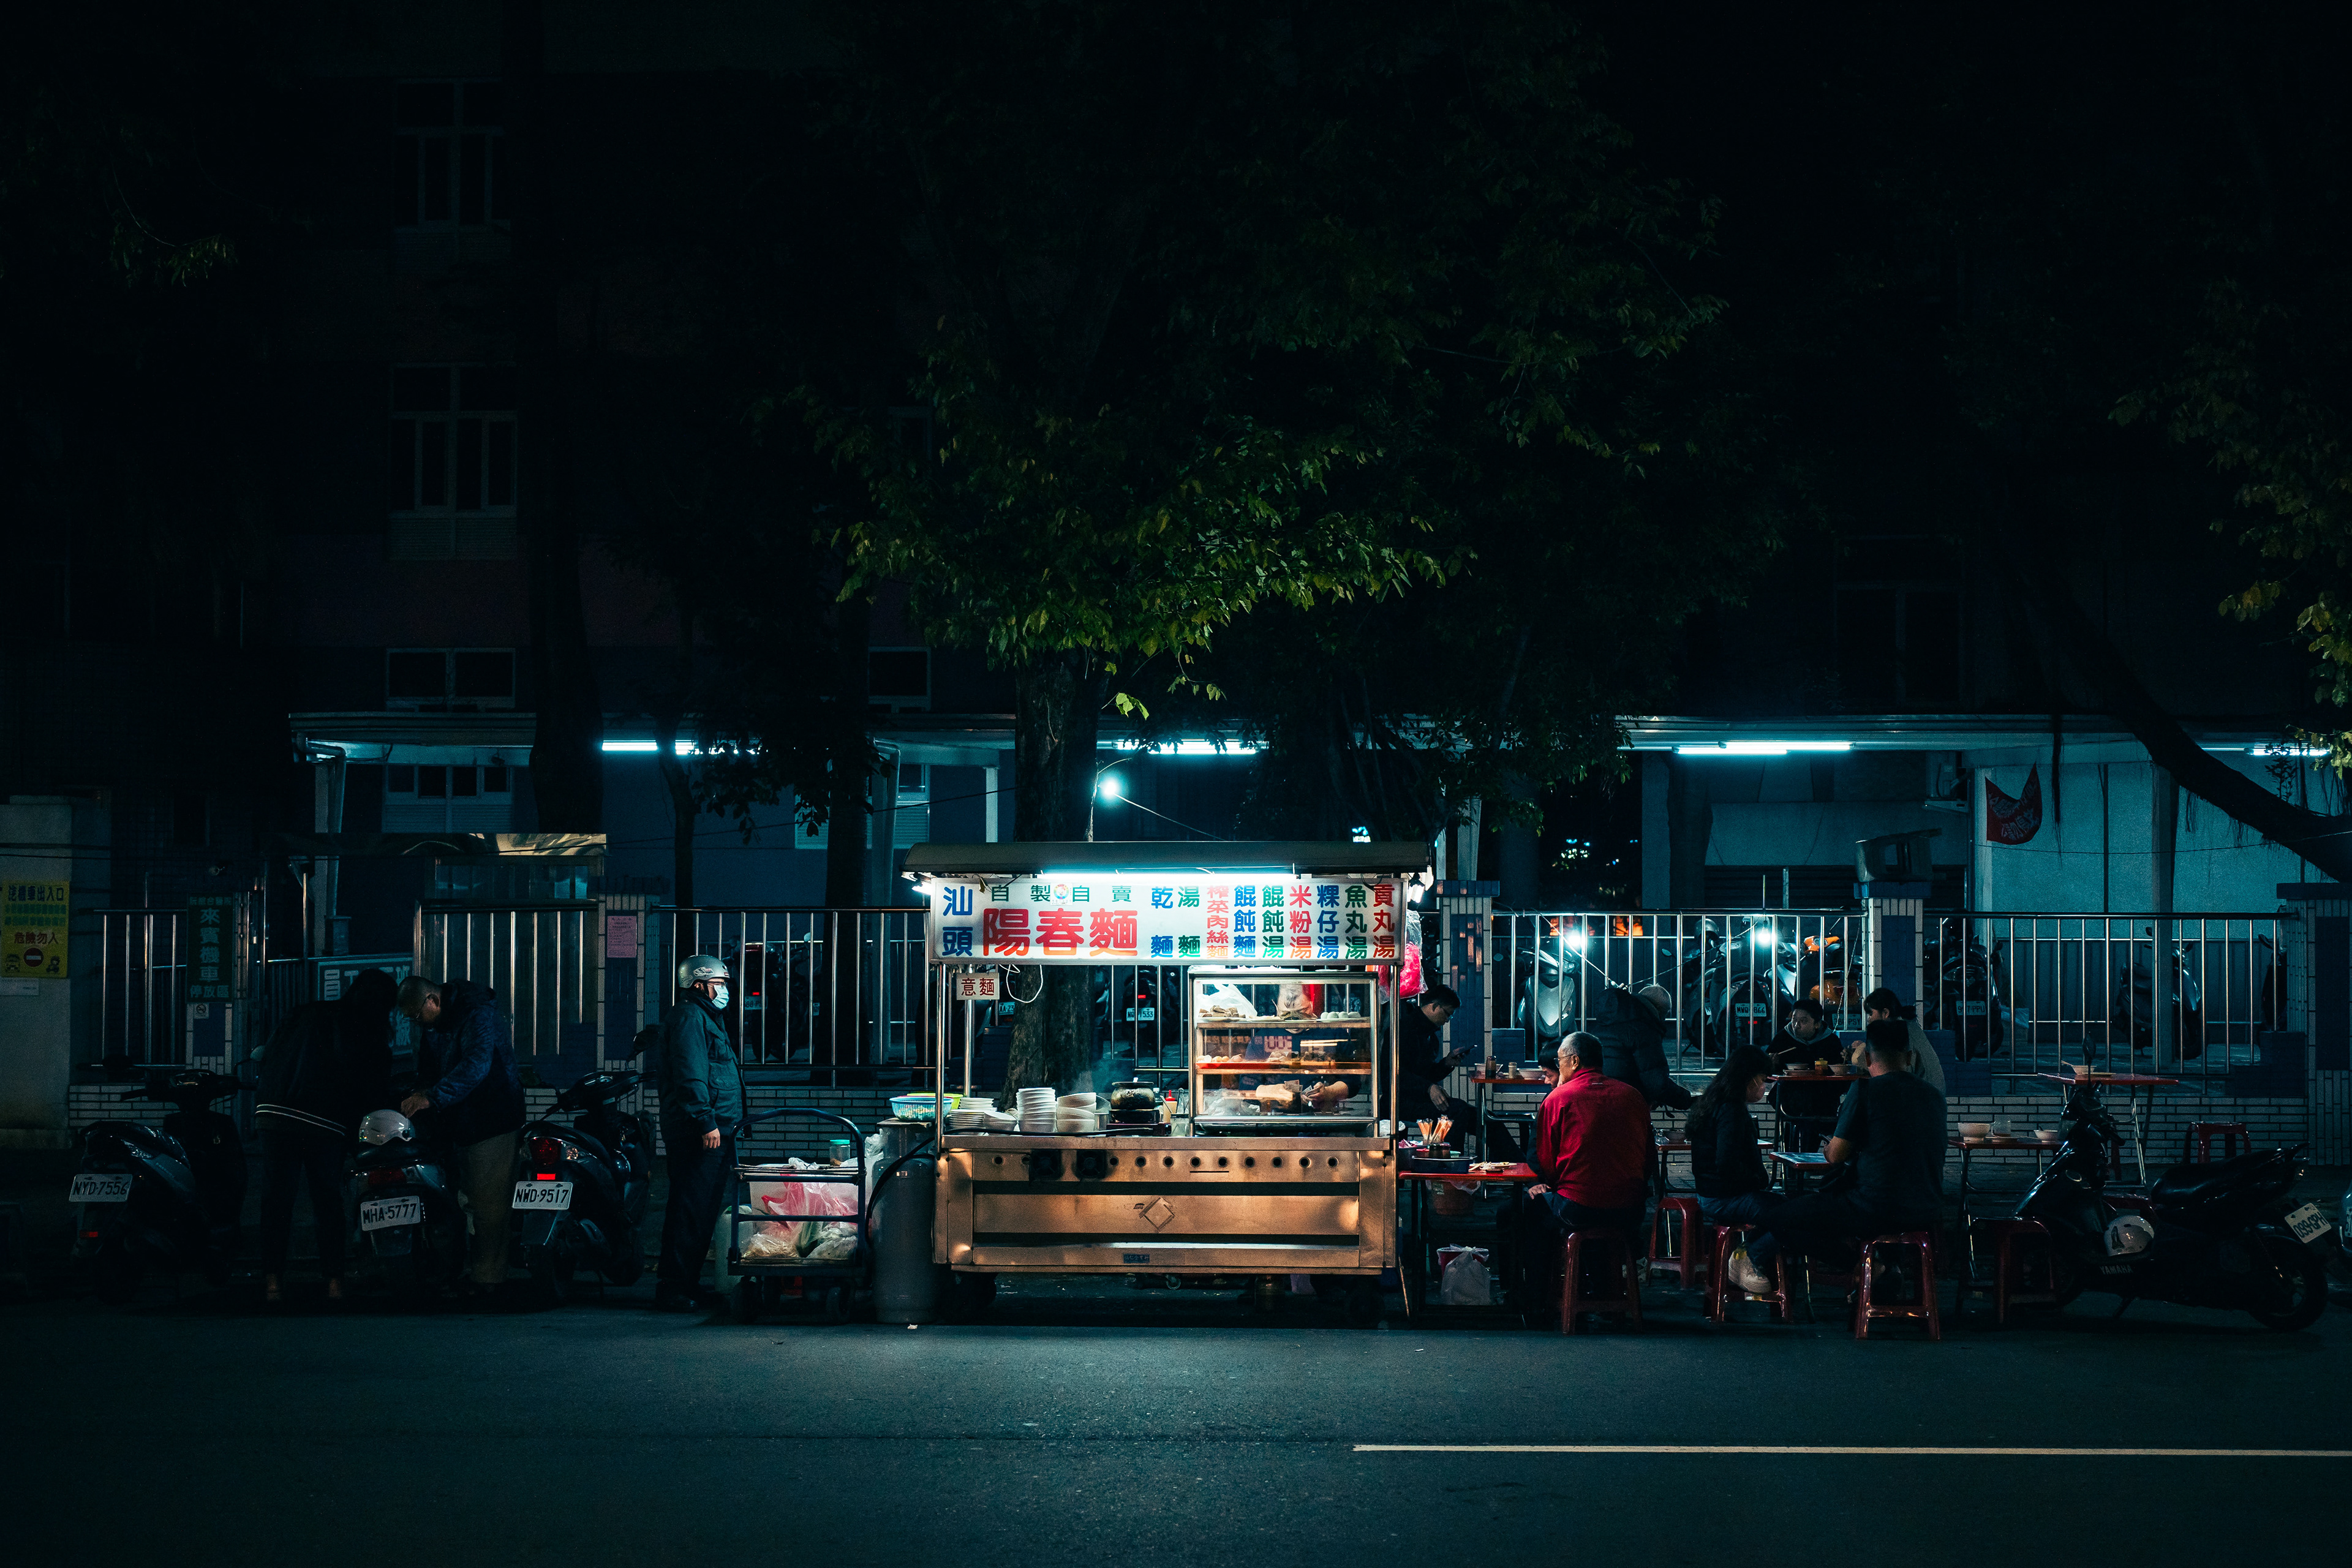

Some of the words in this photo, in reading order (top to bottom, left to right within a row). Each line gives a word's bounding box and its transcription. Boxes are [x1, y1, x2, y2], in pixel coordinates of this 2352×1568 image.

[14, 932, 58, 944] 危險勿入
[942, 886, 973, 957] 汕頭
[982, 908, 1138, 957] 陽春麵
[1151, 886, 1174, 958] 乾麵
[1178, 886, 1200, 958] 湯麵
[1207, 885, 1229, 959] 榨菜肉絲麵
[1234, 885, 1256, 958] 餛飩麵
[1262, 885, 1284, 958] 餛飩湯
[1289, 884, 1312, 959] 米粉湯
[1317, 884, 1340, 959] 粿仔湯
[1345, 885, 1368, 959] 魚丸湯
[1373, 884, 1395, 959] 貢丸湯
[960, 978, 995, 997] 意麵
[2099, 1264, 2134, 1275] YAMAHA
